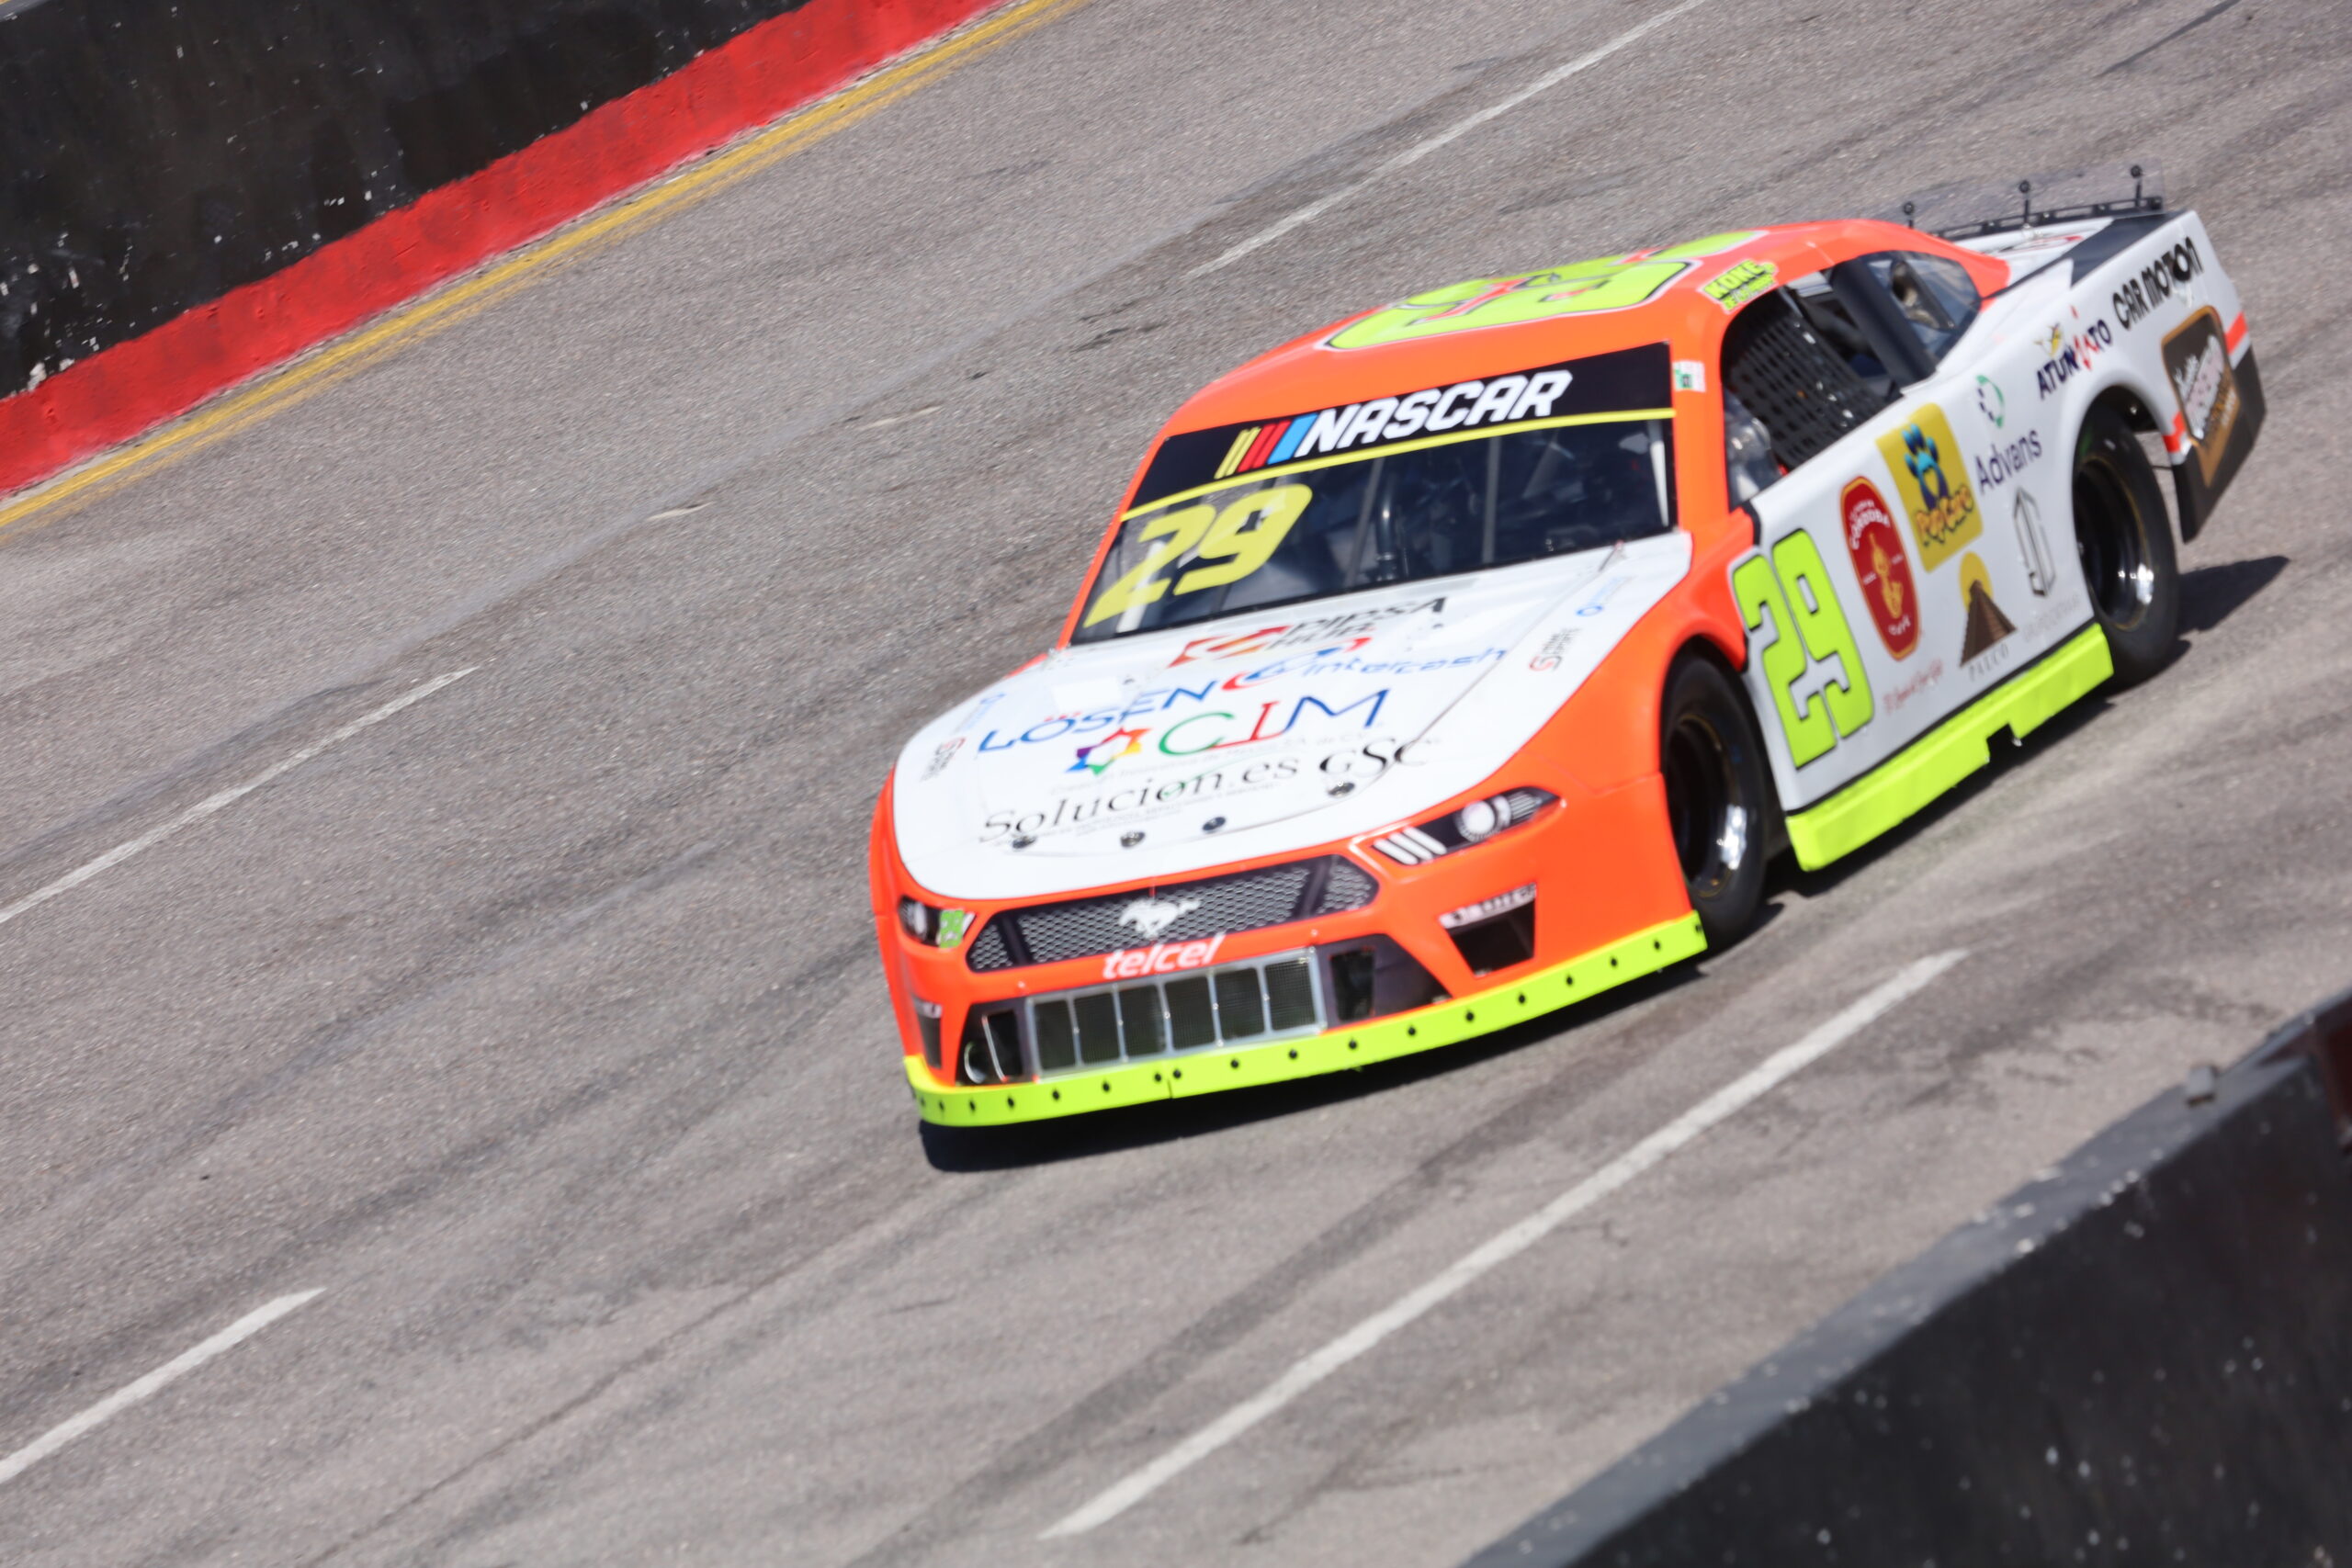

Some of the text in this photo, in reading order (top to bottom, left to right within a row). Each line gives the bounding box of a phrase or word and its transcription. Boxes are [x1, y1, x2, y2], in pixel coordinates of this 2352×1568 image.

[2112, 278, 2151, 332] CAR
[1294, 370, 1573, 458] NASCAR
[1973, 429, 2042, 496] Advans
[1082, 484, 1314, 630] 29
[1730, 526, 1875, 771] 29
[1319, 737, 1442, 780] GSC
[1102, 931, 1227, 980] telcel
